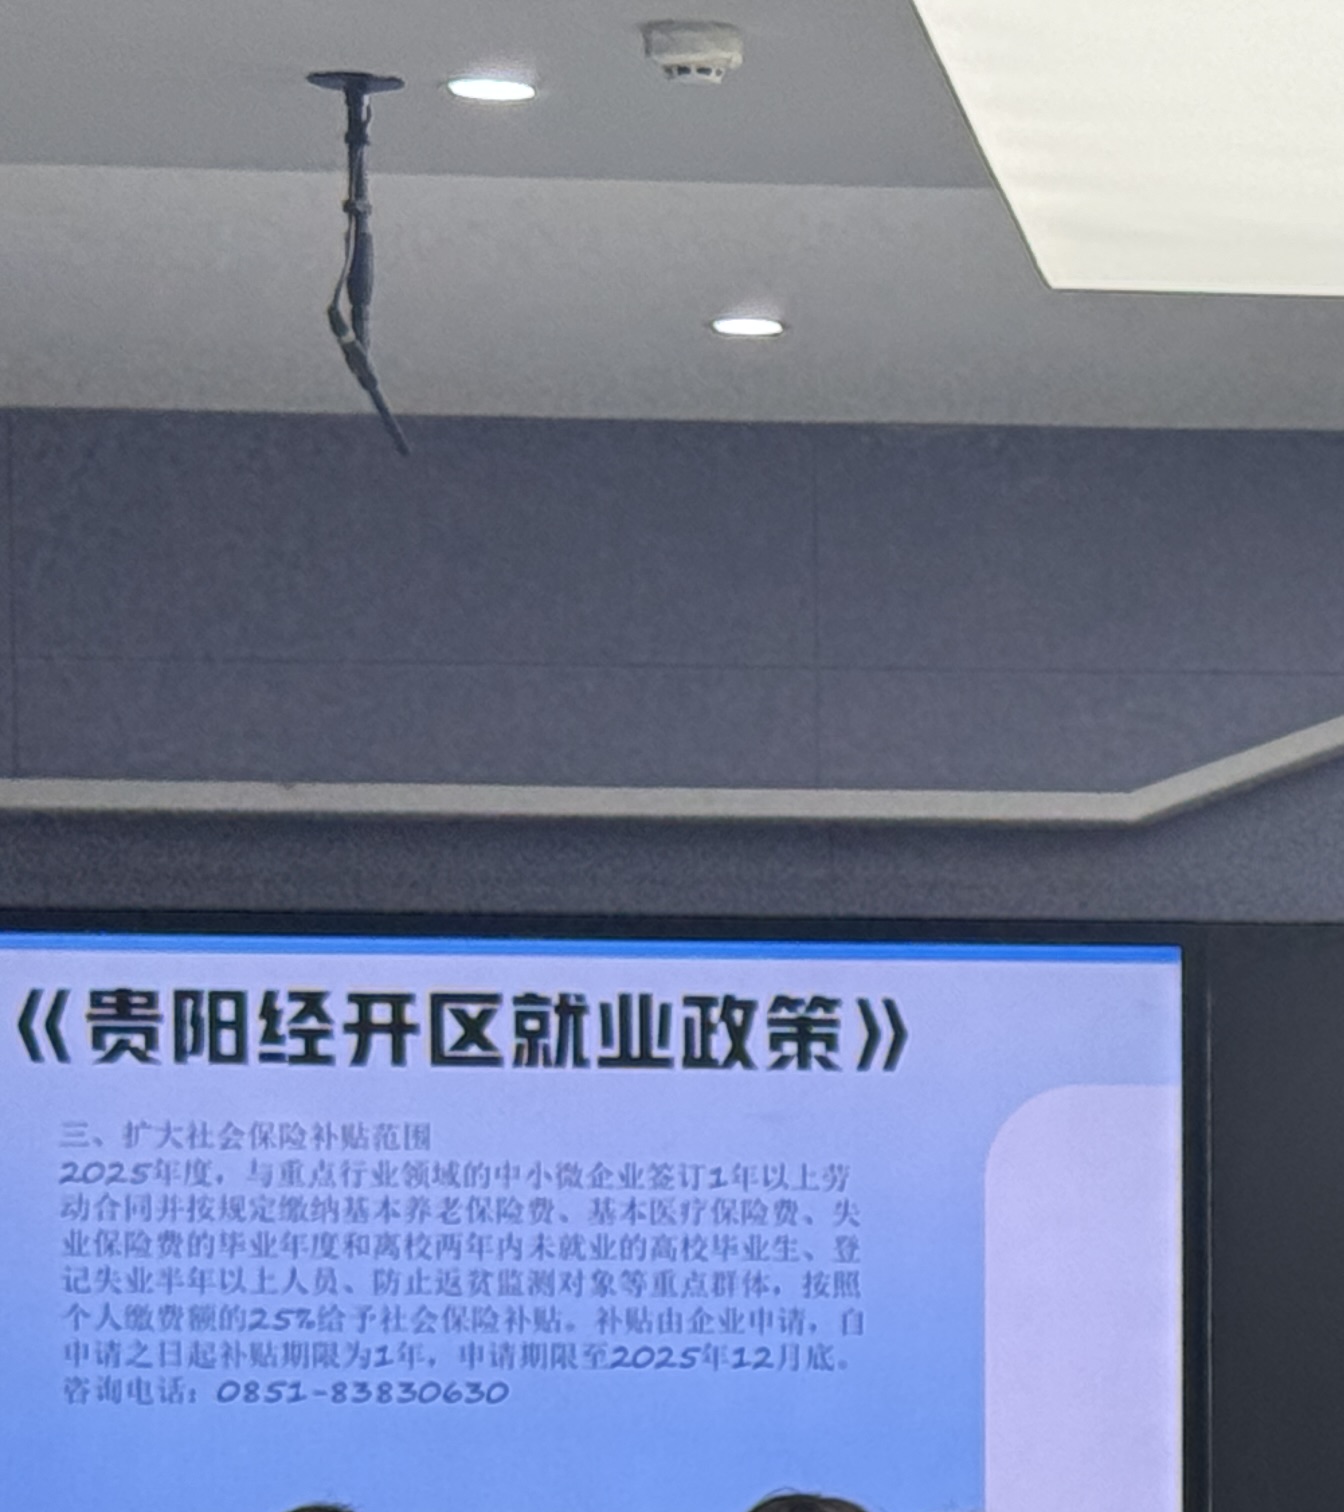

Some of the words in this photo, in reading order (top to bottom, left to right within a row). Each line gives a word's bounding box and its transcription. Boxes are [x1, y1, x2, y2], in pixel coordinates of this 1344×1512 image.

[18, 988, 908, 1072] 《贵阳经开区就业政策》
[58, 1120, 431, 1151] 三、扩大社会保险补贴范围
[60, 1193, 861, 1227] 动合同并按规定缴纳基本养老保险费、基本医疗保险费、失
[62, 1229, 861, 1264] 业保险费的毕业年度和离校两年内未就业的高校毕业生、登
